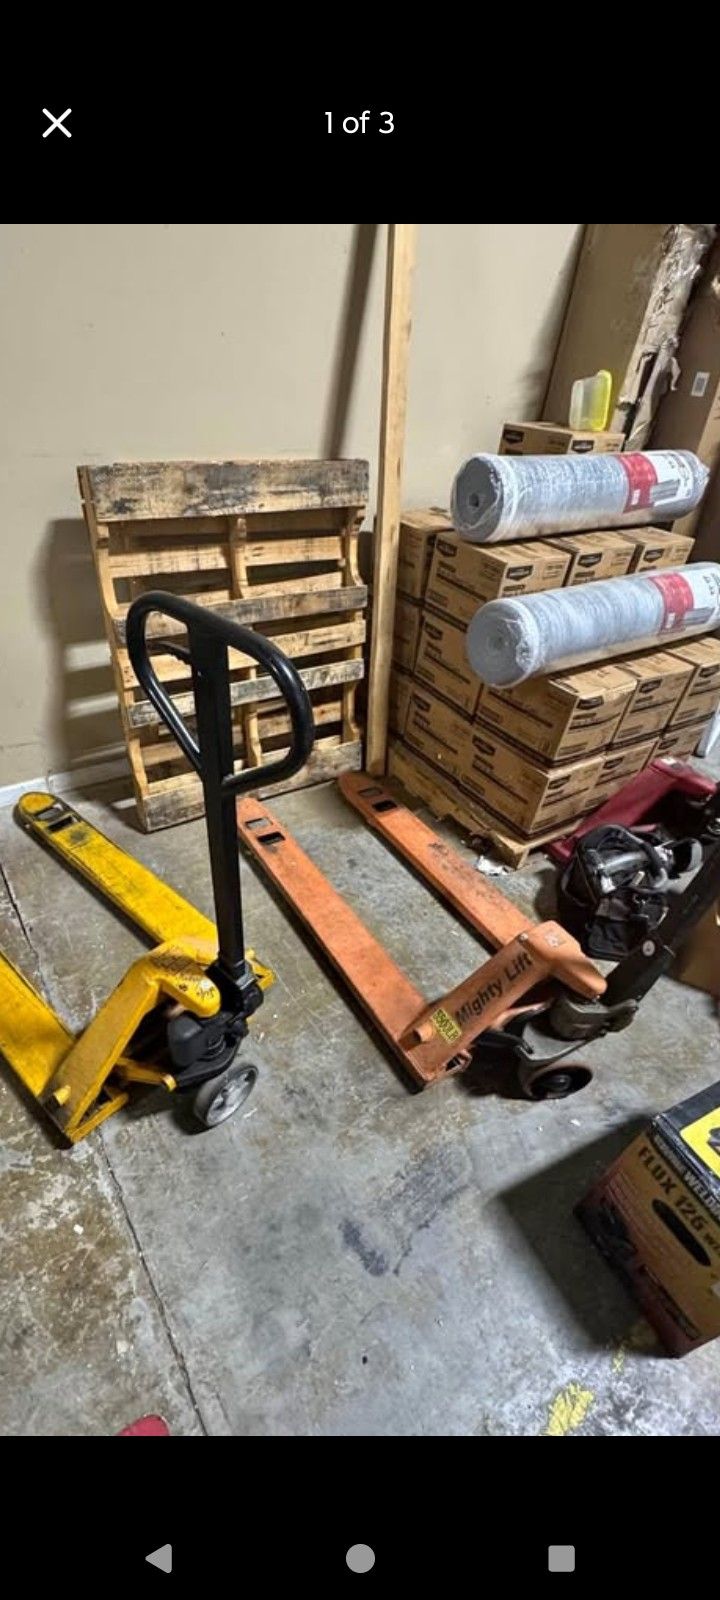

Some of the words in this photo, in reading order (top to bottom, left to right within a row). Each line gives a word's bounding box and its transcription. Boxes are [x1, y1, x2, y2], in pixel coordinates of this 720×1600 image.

[455, 981, 503, 1026] Mighty
[504, 952, 532, 981] Lift
[638, 1147, 676, 1194] FLUX
